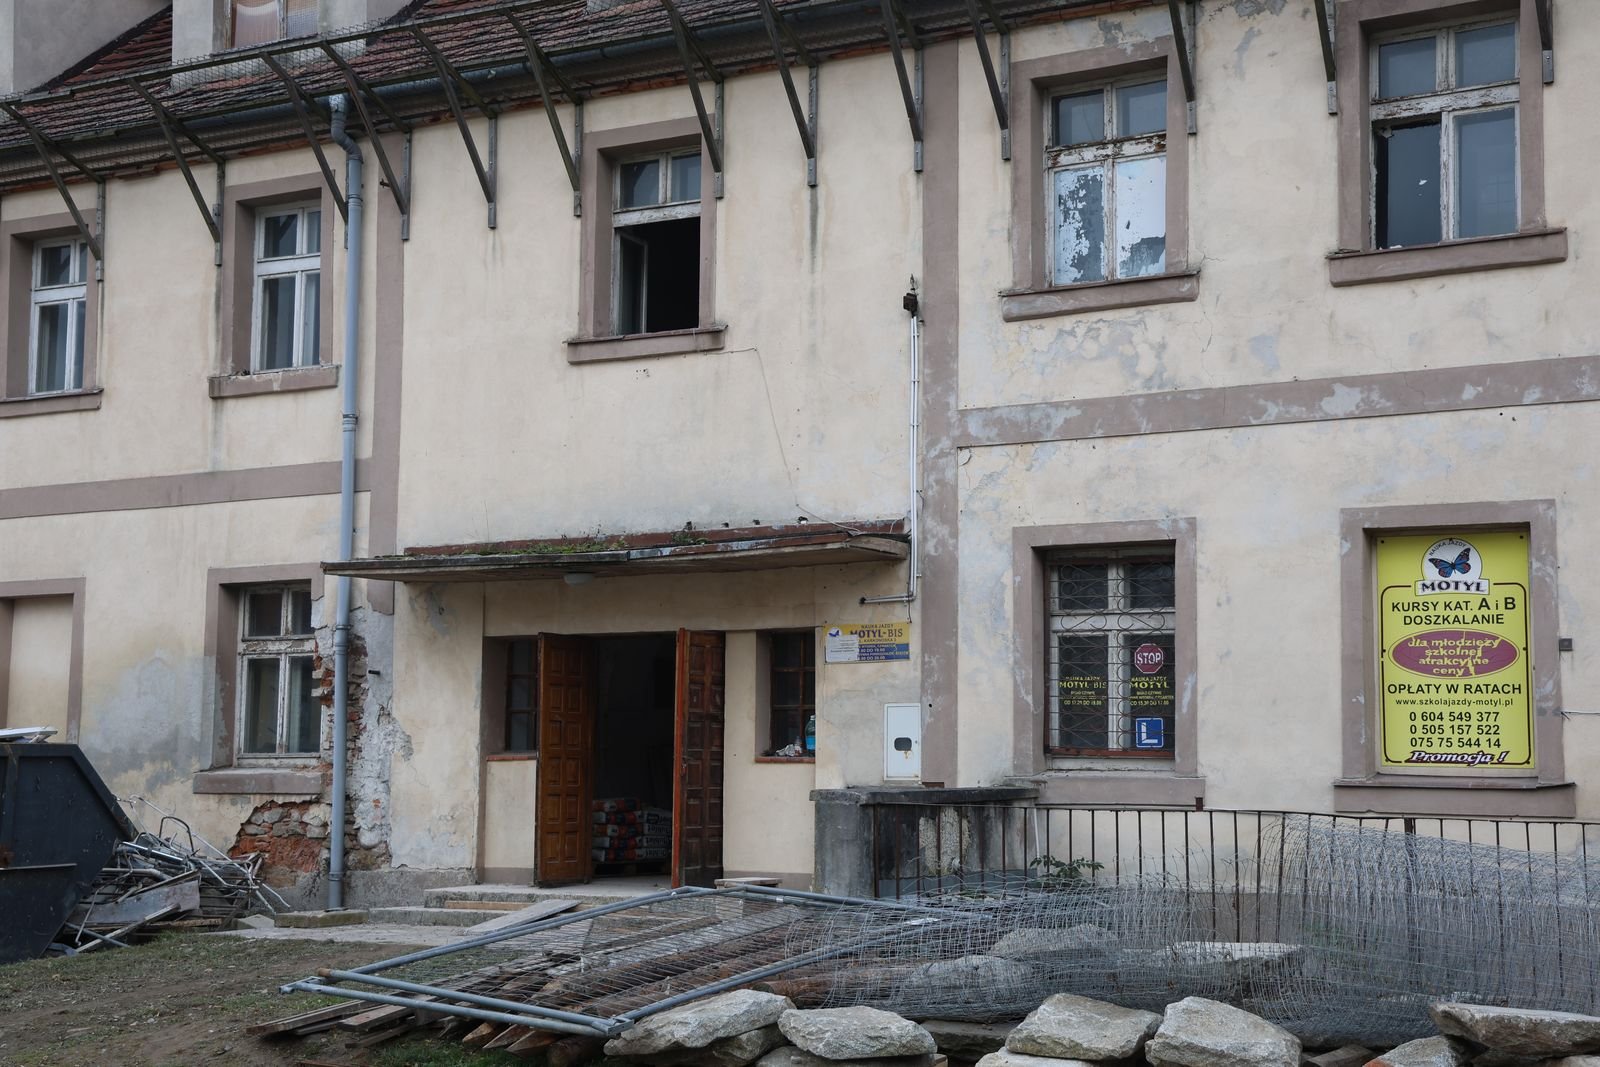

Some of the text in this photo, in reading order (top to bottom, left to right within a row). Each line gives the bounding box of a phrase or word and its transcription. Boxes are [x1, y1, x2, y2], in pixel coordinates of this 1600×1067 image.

[1428, 540, 1466, 556] NAUKA JAZDY
[1420, 580, 1486, 592] MOTYL
[1392, 596, 1516, 612] KURSY KAT. A i B
[1404, 614, 1504, 626] DOSZKALANIE
[1408, 638, 1500, 648] dla młodzieży
[1137, 652, 1161, 664] STOP
[1425, 647, 1482, 658] szkolnej
[1419, 657, 1489, 669] atrakcyjne
[1433, 668, 1464, 676] ceny
[1388, 683, 1522, 694] OPŁATY W RATACH
[1396, 698, 1513, 707] www.szkolajazdy-motyl.pl
[1410, 712, 1500, 722] 0 604 549 377
[1142, 722, 1158, 744] L
[1410, 725, 1500, 735] 0 505 157 522
[1410, 738, 1501, 748] 075 75 544 14
[1407, 750, 1493, 766] Promocja
